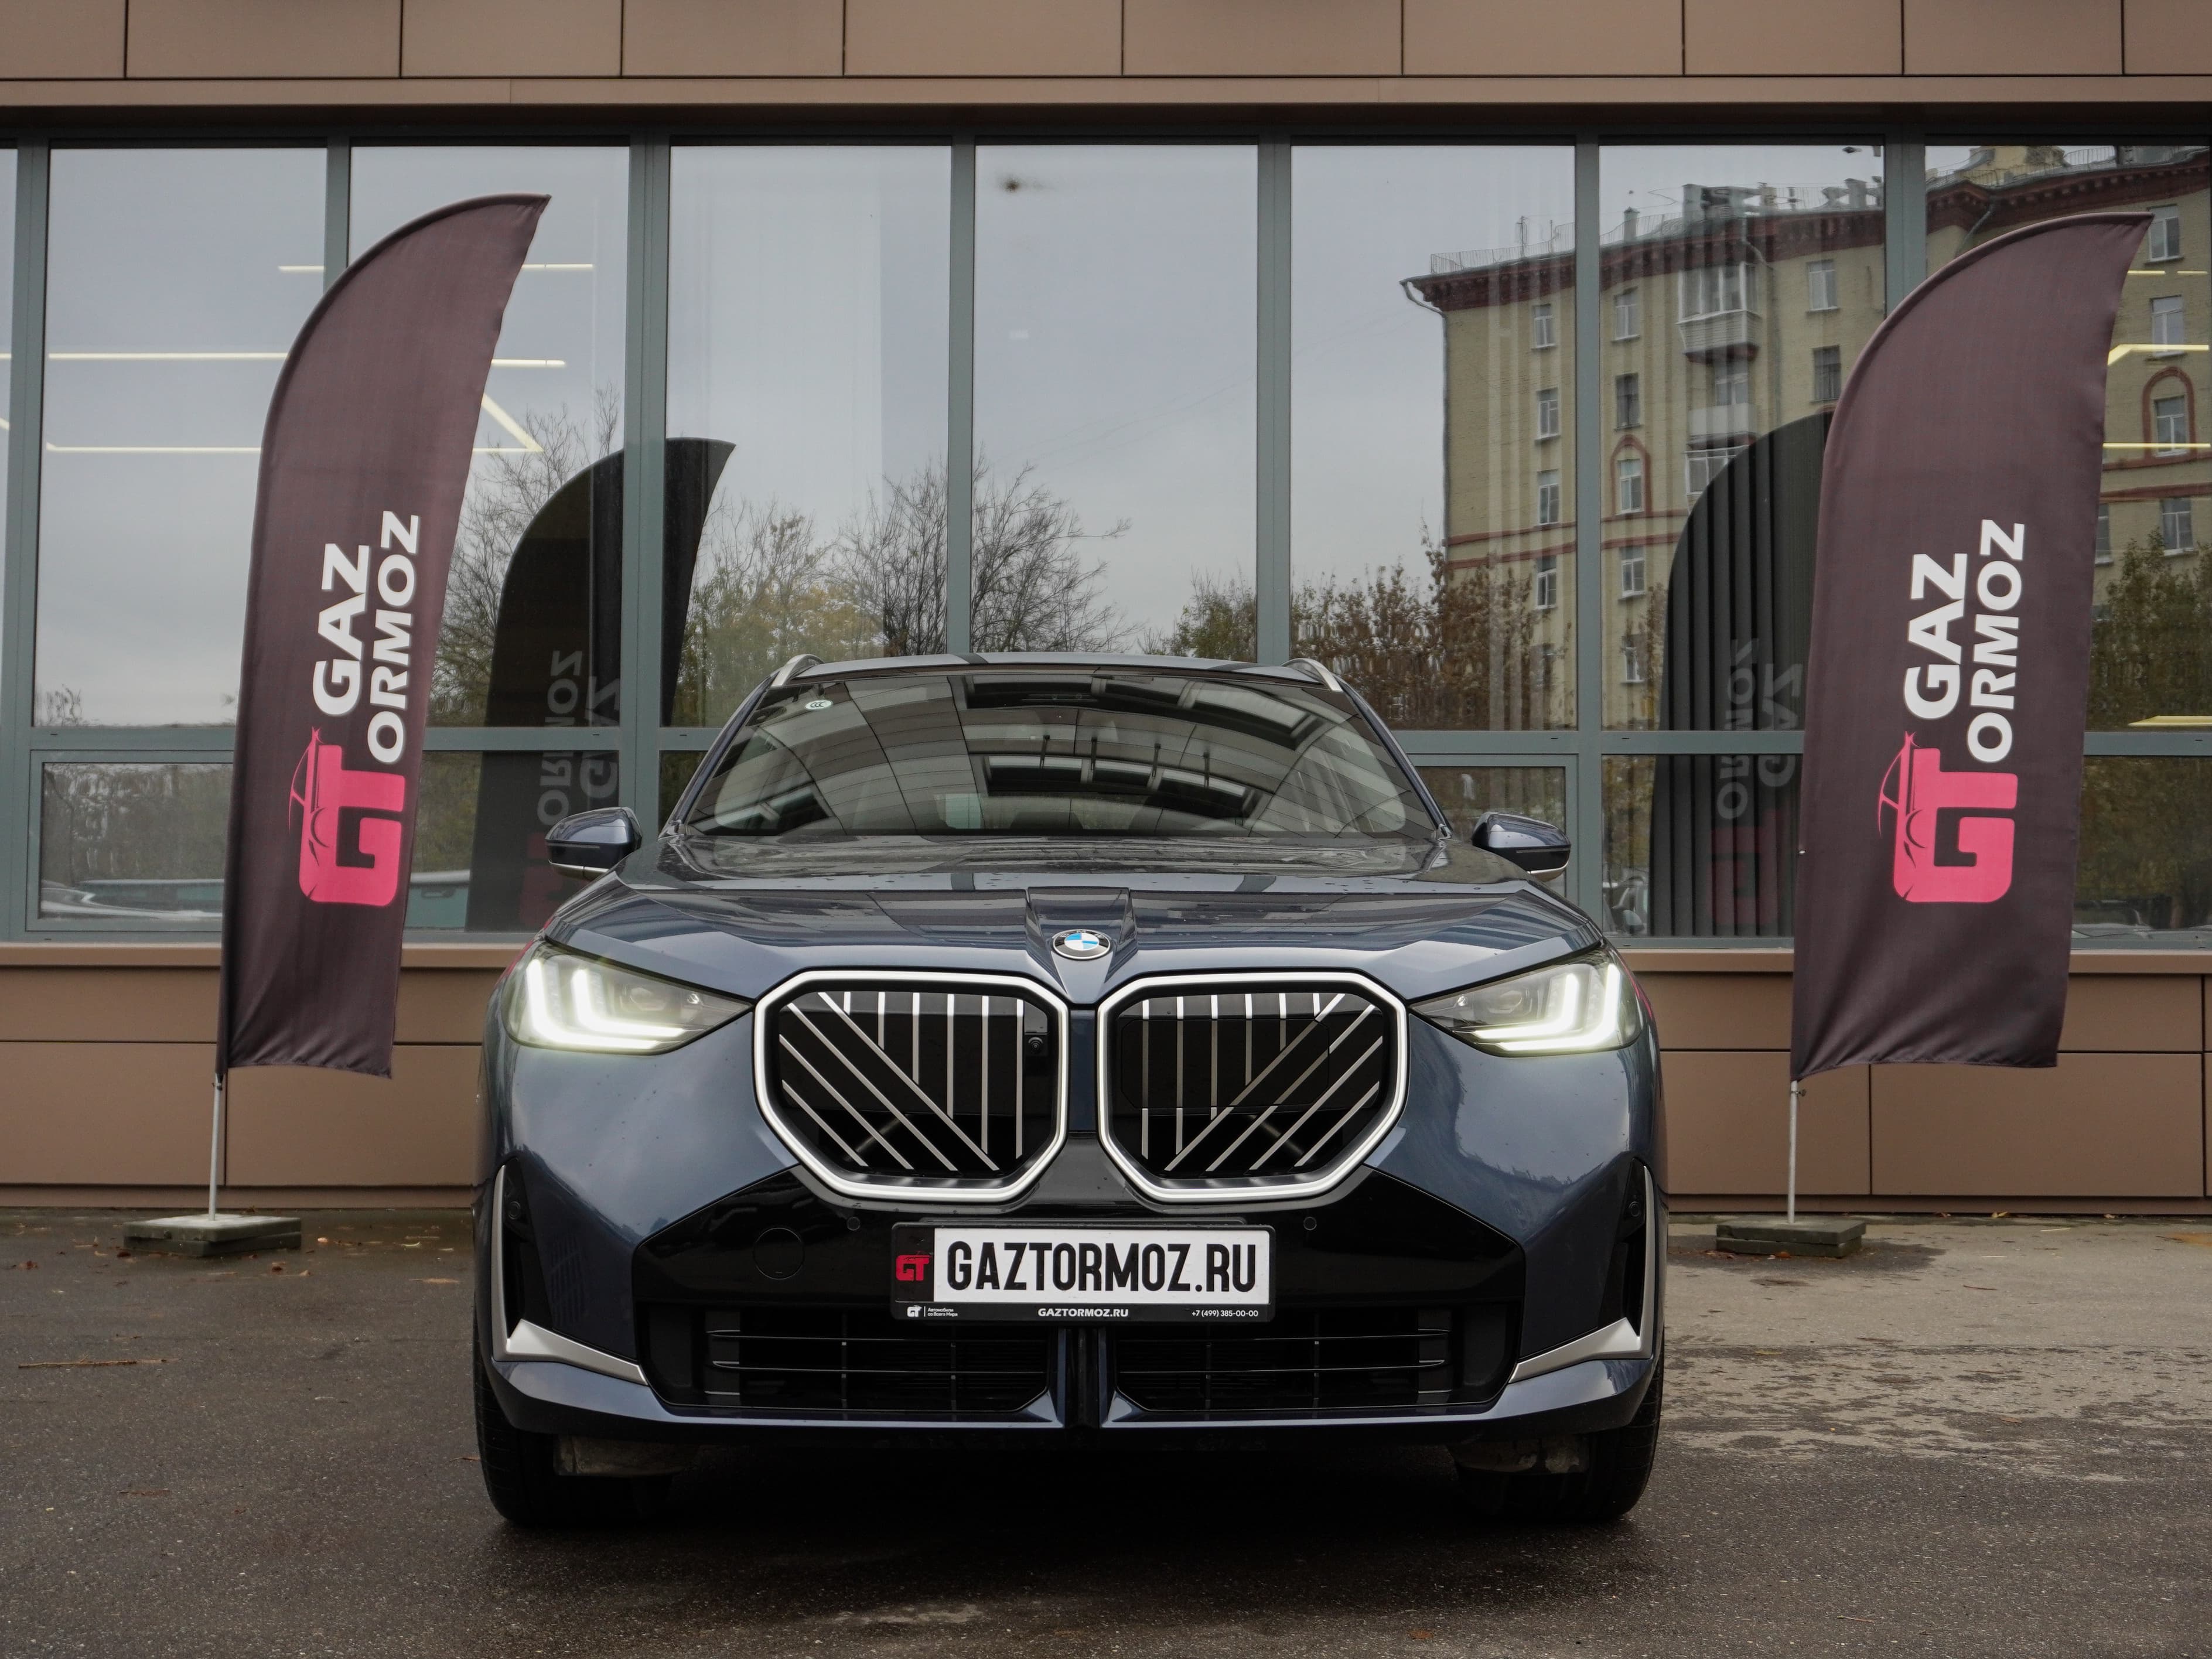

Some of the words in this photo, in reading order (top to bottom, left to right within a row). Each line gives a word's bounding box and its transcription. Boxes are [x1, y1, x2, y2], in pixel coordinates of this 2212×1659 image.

[312, 543, 370, 716] GAZ
[367, 510, 419, 763] ORMOZ
[1903, 553, 1968, 719] GAZ
[1967, 518, 2025, 763] ORMOZ
[947, 1241, 1256, 1292] GAZTORMOZ.RU
[1038, 1308, 1128, 1317] GAZTORMOZ.RU
